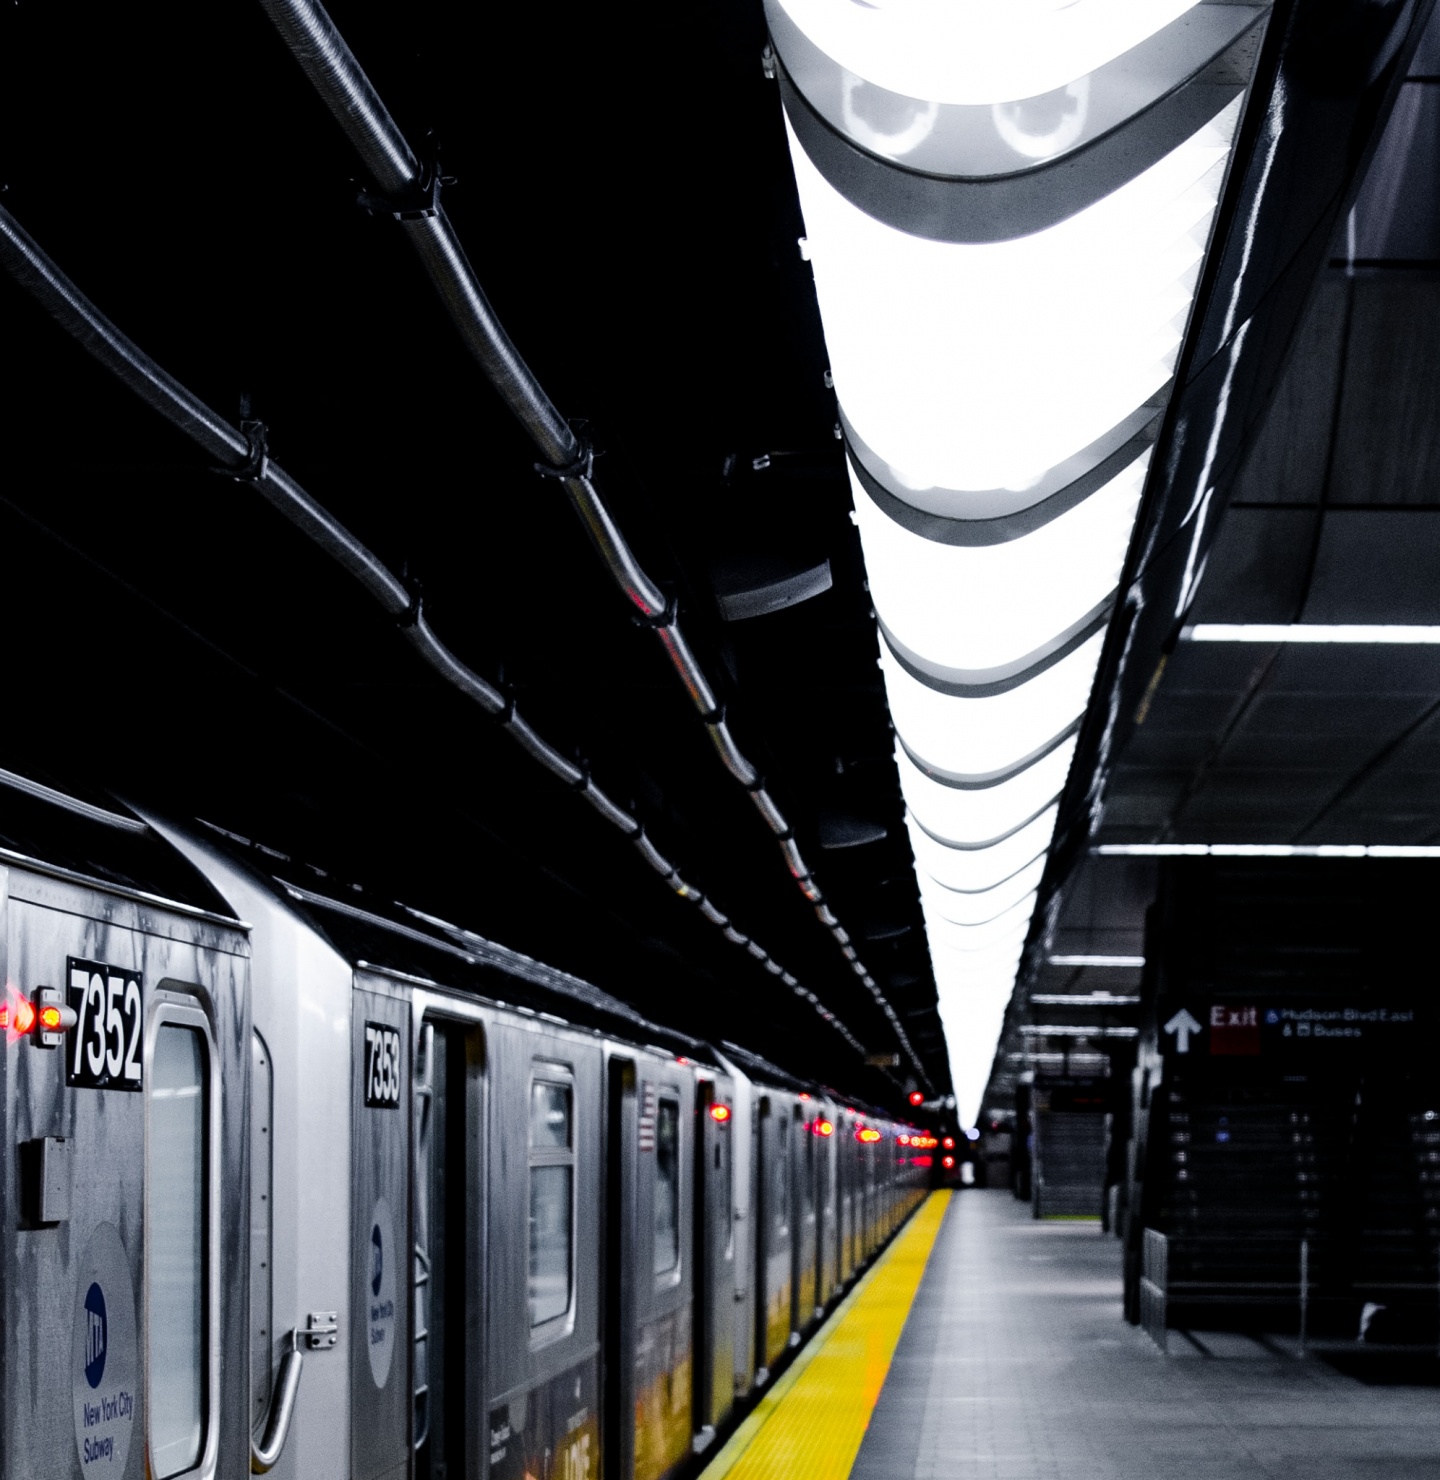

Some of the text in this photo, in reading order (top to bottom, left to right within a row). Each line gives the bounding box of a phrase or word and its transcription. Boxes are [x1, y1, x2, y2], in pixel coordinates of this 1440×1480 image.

[71, 968, 142, 1080] 7352
[1210, 1006, 1257, 1026] Exit
[1281, 1008, 1414, 1022] Hudson Blvd East
[1313, 1023, 1362, 1037] Buses
[366, 1027, 400, 1101] 7353
[84, 1391, 133, 1428] New York City
[84, 1436, 114, 1464] Subway
